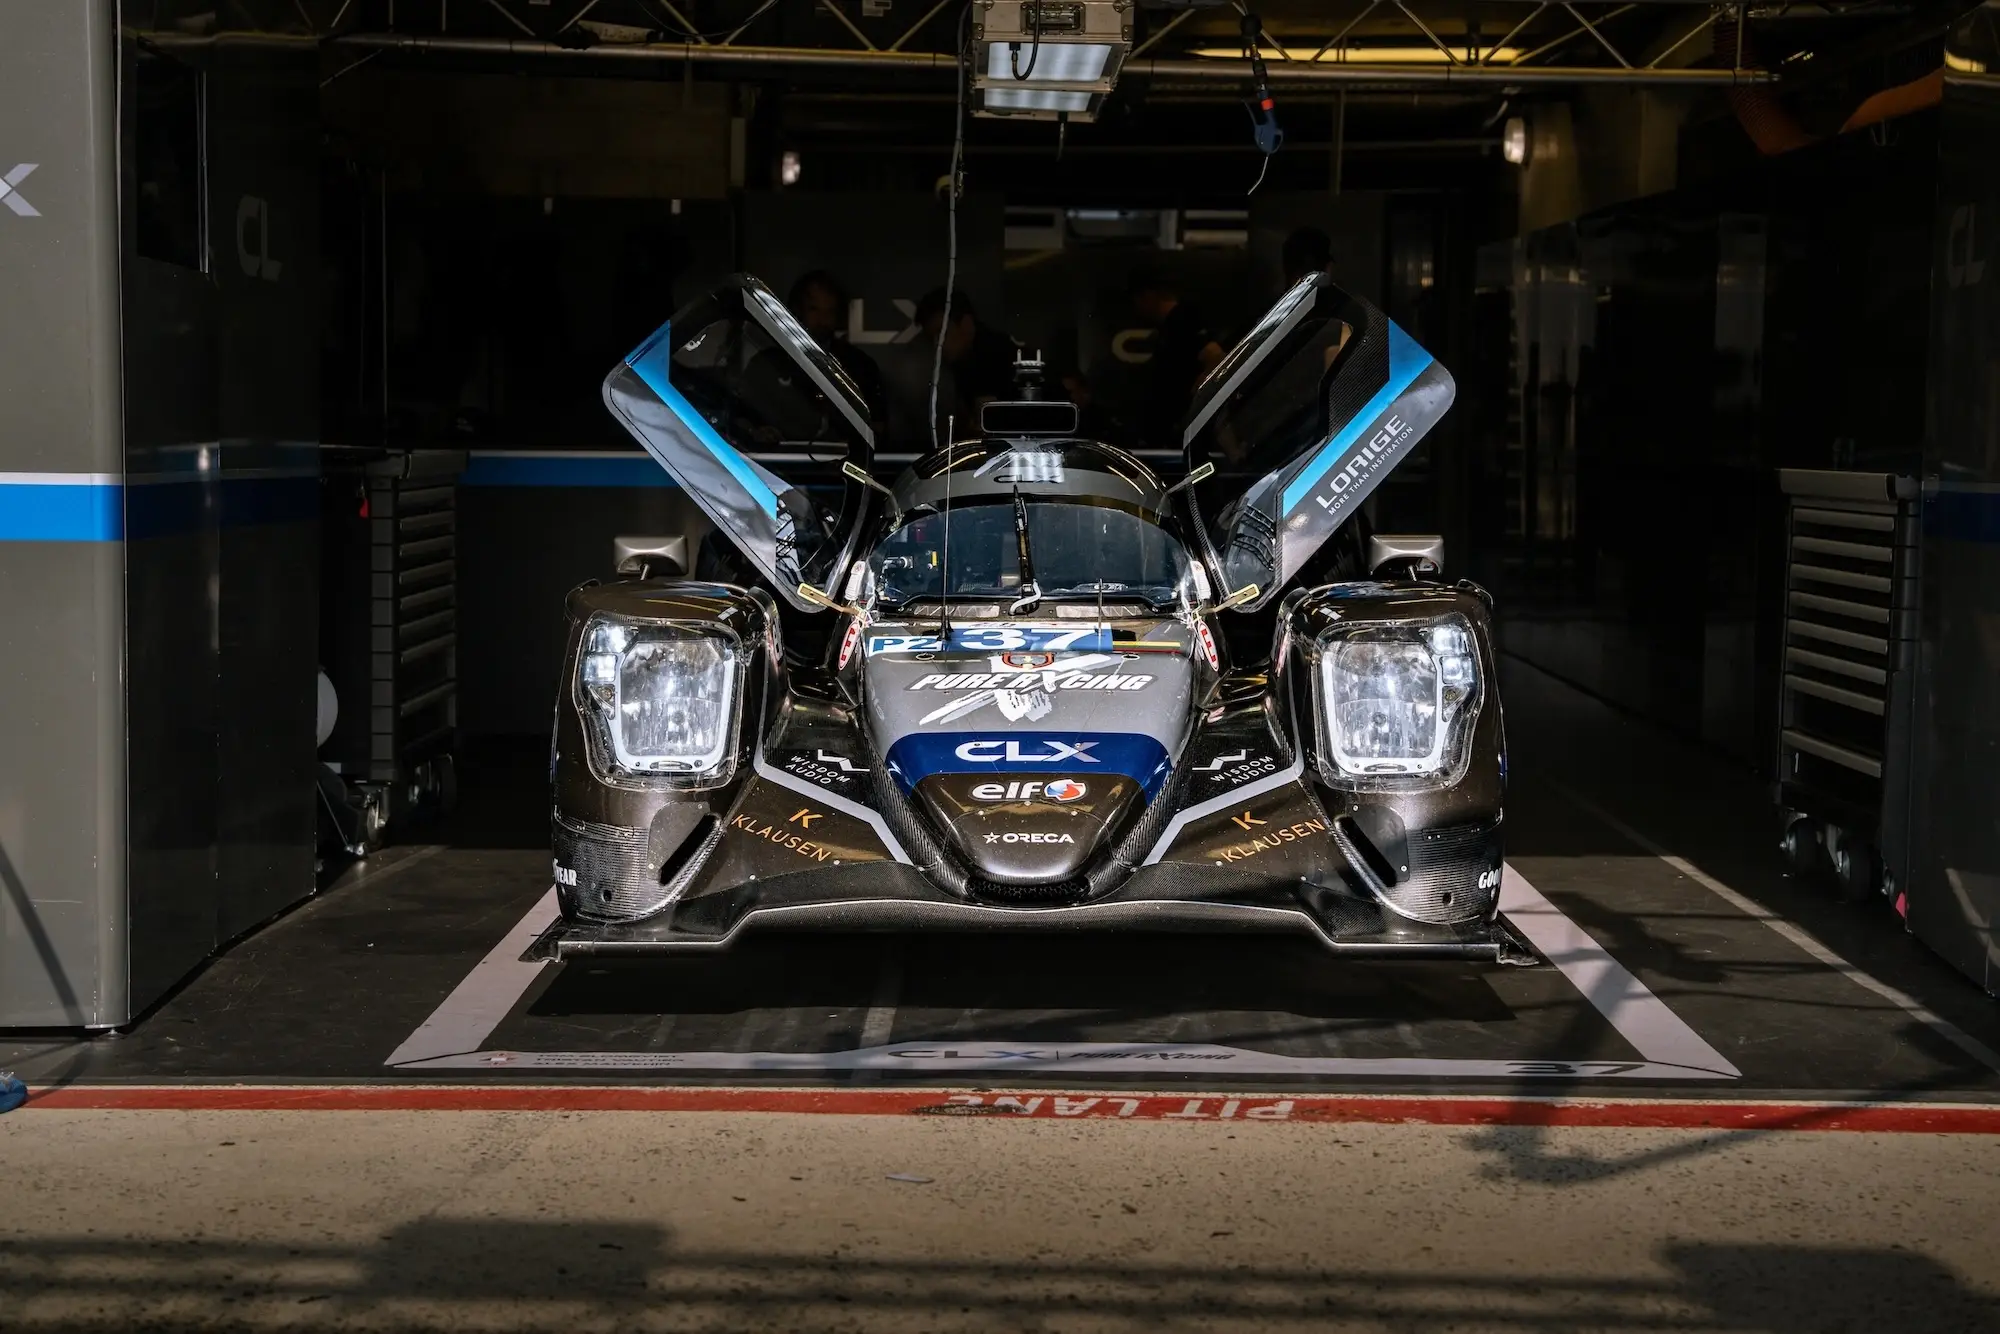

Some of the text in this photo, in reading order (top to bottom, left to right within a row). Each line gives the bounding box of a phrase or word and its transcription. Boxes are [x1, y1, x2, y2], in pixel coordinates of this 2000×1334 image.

[1315, 414, 1407, 510] LORIGE
[1328, 426, 1414, 516] MORE THAN INSPIRATION
[872, 638, 938, 653] P2
[960, 628, 1096, 651] 37
[909, 673, 1012, 691] PURE
[955, 740, 1101, 763] CLX
[785, 763, 832, 784] AUDIO
[790, 755, 851, 783] WISDOM
[1210, 755, 1274, 782] WISDOM
[1231, 763, 1276, 785] AUDIO
[972, 780, 1045, 800] elf
[730, 813, 831, 862] KLAUSEN
[1002, 832, 1075, 844] ORECA
[1220, 818, 1326, 864] KLAUSEN
[887, 1050, 1045, 1060] CLX
[1506, 1062, 1645, 1075] 37
[1161, 1098, 1296, 1120] PIT
